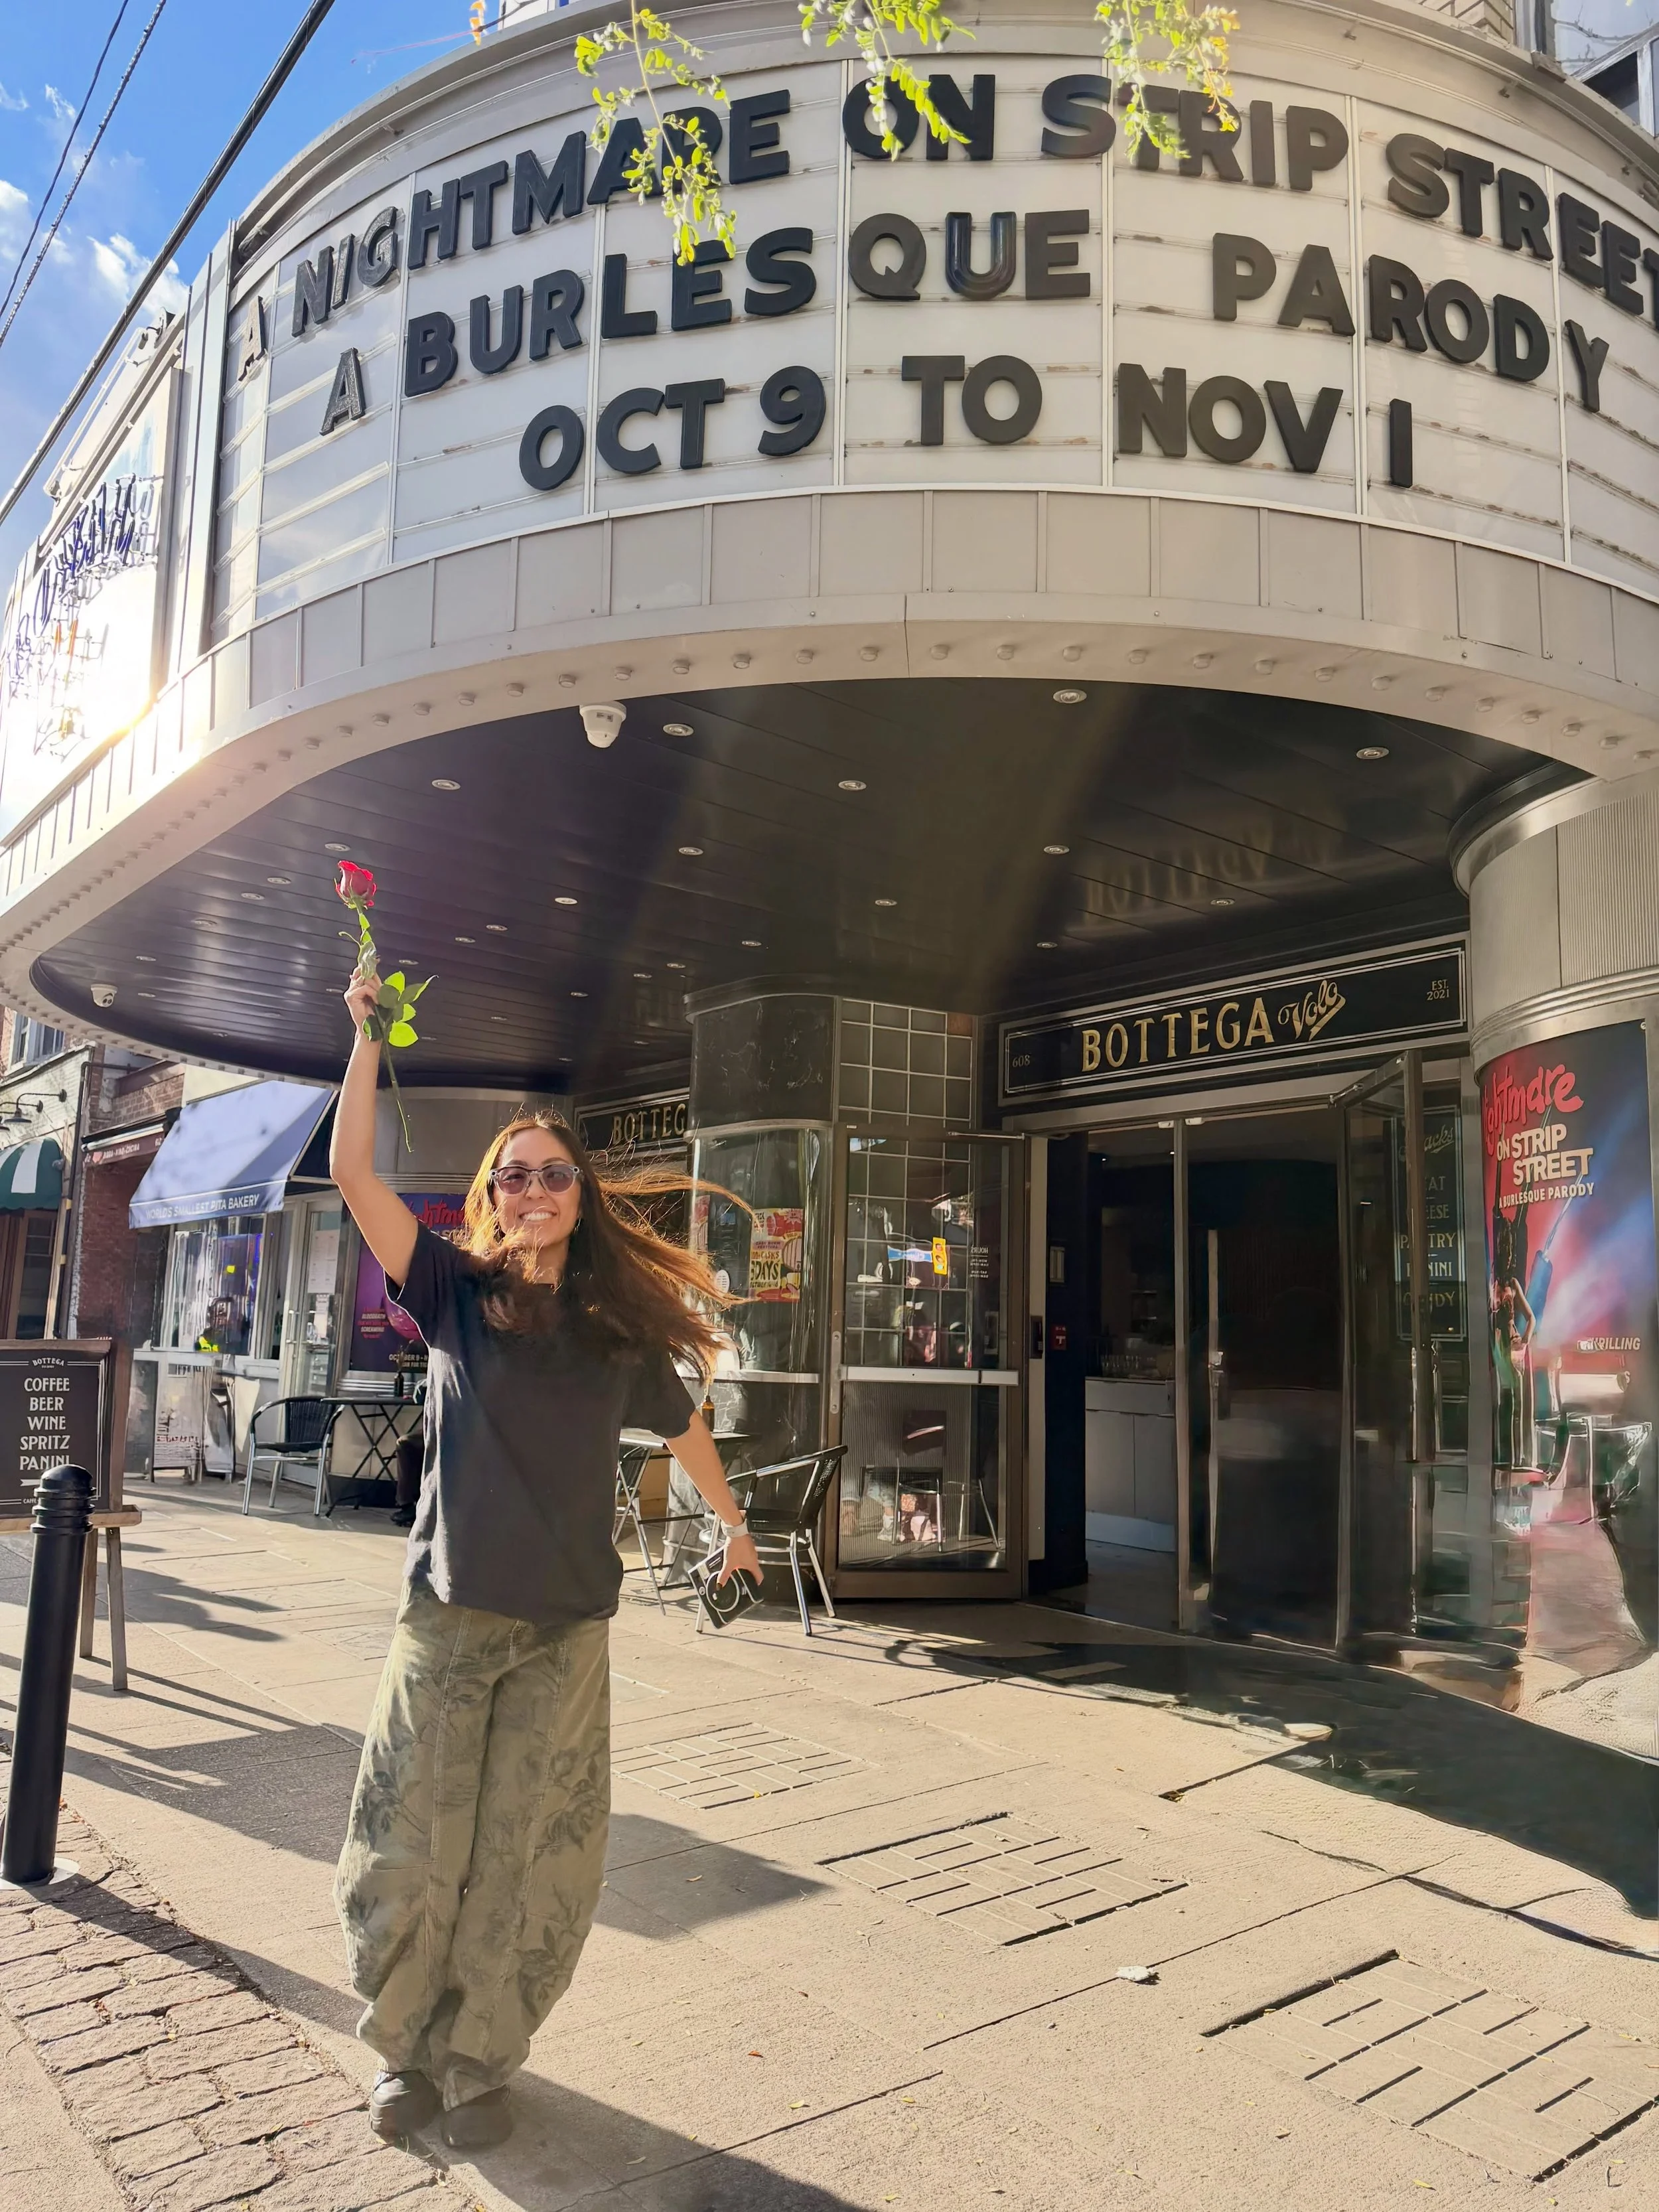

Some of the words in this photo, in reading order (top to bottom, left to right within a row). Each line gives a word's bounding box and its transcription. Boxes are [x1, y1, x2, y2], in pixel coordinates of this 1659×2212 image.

[238, 296, 267, 381] A
[291, 89, 790, 337] NIGHTMARE
[842, 73, 996, 161] ON
[1041, 73, 1349, 192] STRIP
[319, 347, 365, 436] A
[1212, 231, 1609, 413] PARODY
[518, 378, 725, 491] OCT
[757, 365, 826, 457] 9
[901, 354, 1043, 446] TO
[1116, 363, 1344, 474] NOV
[1431, 979, 1449, 991] EST.
[1427, 989, 1450, 1001] 2021
[1080, 997, 1275, 1072] BOTTEGA
[1277, 980, 1346, 1042] Volo
[1012, 1054, 1031, 1068] 608
[613, 1103, 686, 1145] BOTTEG
[1497, 1138, 1510, 1161] ON
[1512, 1124, 1567, 1159] STRIP
[1513, 1147, 1593, 1185] STREET
[210, 1199, 226, 1211] PITA
[228, 1194, 260, 1209] BAKERY
[1498, 1197, 1502, 1209] A
[1503, 1188, 1545, 1209] BURLESQUE
[1548, 1183, 1594, 1199] PARODY
[1400, 1232, 1456, 1248] PTRY
[32, 1357, 64, 1366] BOTTEGA
[25, 1378, 70, 1392] COFFEE
[29, 1397, 64, 1411] BEER
[27, 1416, 66, 1430] WINE
[20, 1435, 70, 1450] SPRITZ
[20, 1455, 70, 1470] PANINI
